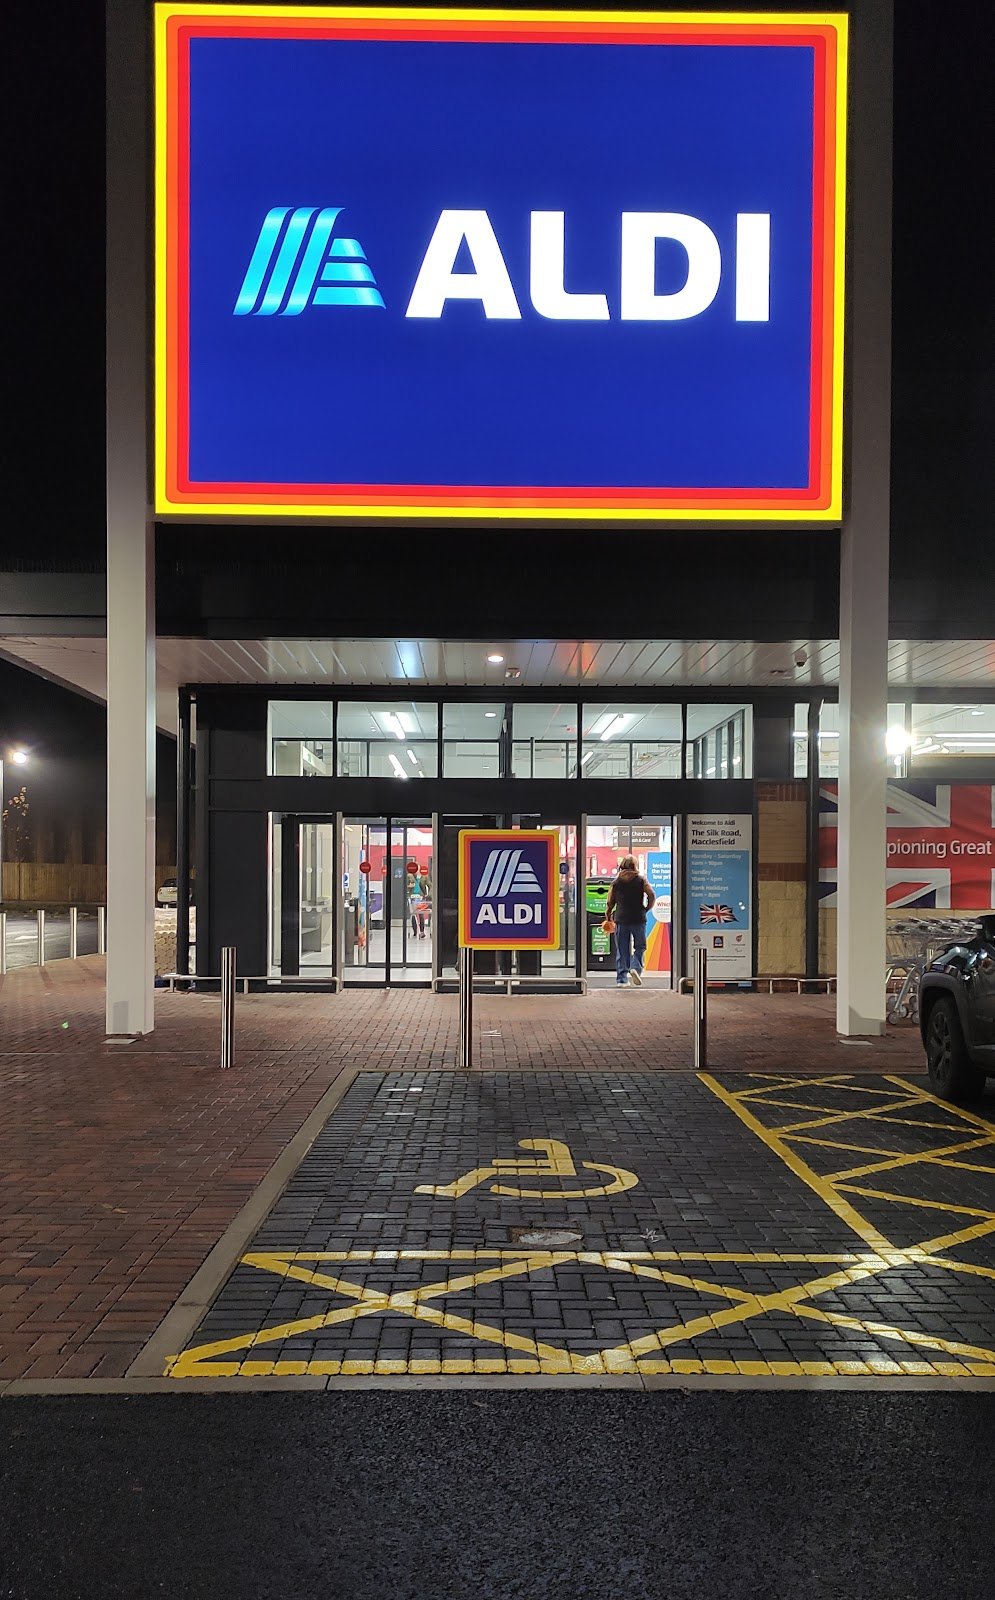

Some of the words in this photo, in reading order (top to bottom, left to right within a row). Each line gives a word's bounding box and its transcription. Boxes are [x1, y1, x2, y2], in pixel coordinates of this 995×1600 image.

[405, 209, 771, 322] ALDI
[691, 829, 705, 837] The
[706, 829, 720, 837] Silk
[720, 829, 742, 838] Road,
[691, 838, 736, 846] Macclesfield
[886, 838, 947, 859] pioning
[950, 840, 992, 855] Great
[475, 903, 542, 924] ALDI
